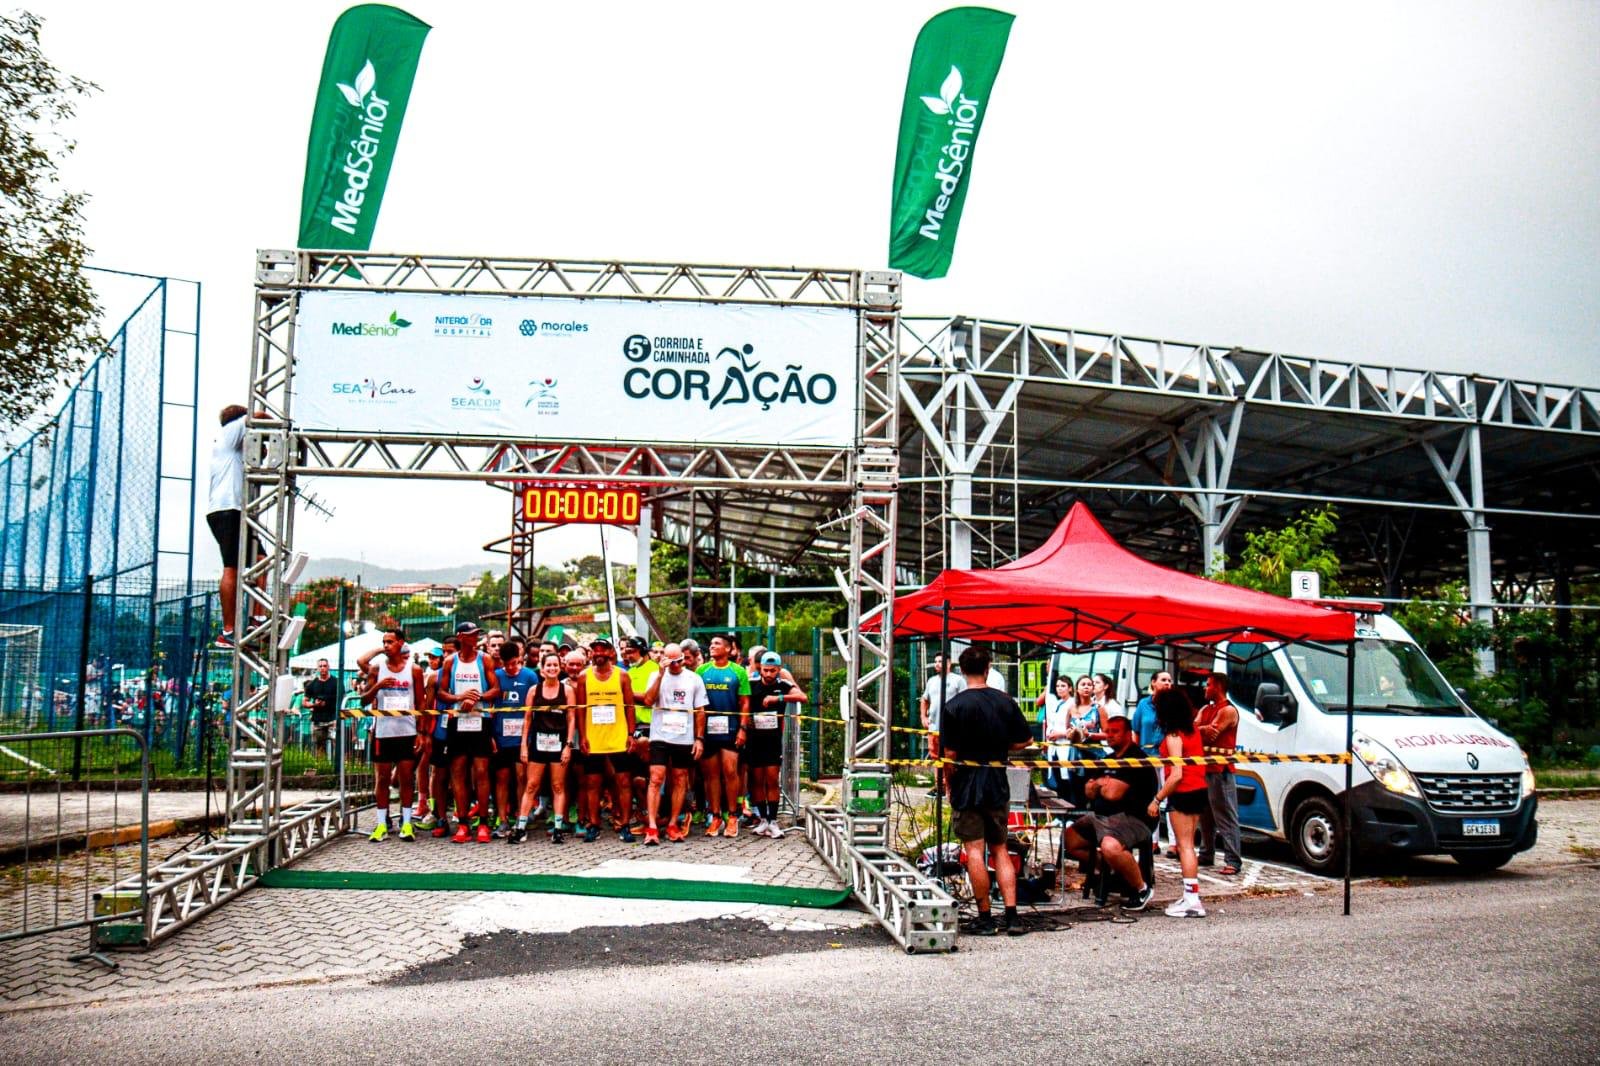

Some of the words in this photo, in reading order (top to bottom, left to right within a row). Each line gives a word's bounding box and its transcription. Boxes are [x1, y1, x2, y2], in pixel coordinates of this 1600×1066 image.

[330, 90, 390, 235] MedSênior
[919, 93, 979, 241] MedSênior
[331, 321, 400, 337] MedSênior
[435, 328, 491, 336] HOSPITAL
[541, 321, 589, 332] morales
[654, 337, 695, 350] CORRIDA
[697, 338, 704, 350] E
[653, 350, 711, 364] CAMINHADA
[379, 381, 416, 395] Care
[623, 364, 837, 411] CORAÇÃO
[525, 490, 638, 521] 00:00:00
[1302, 578, 1309, 590] E
